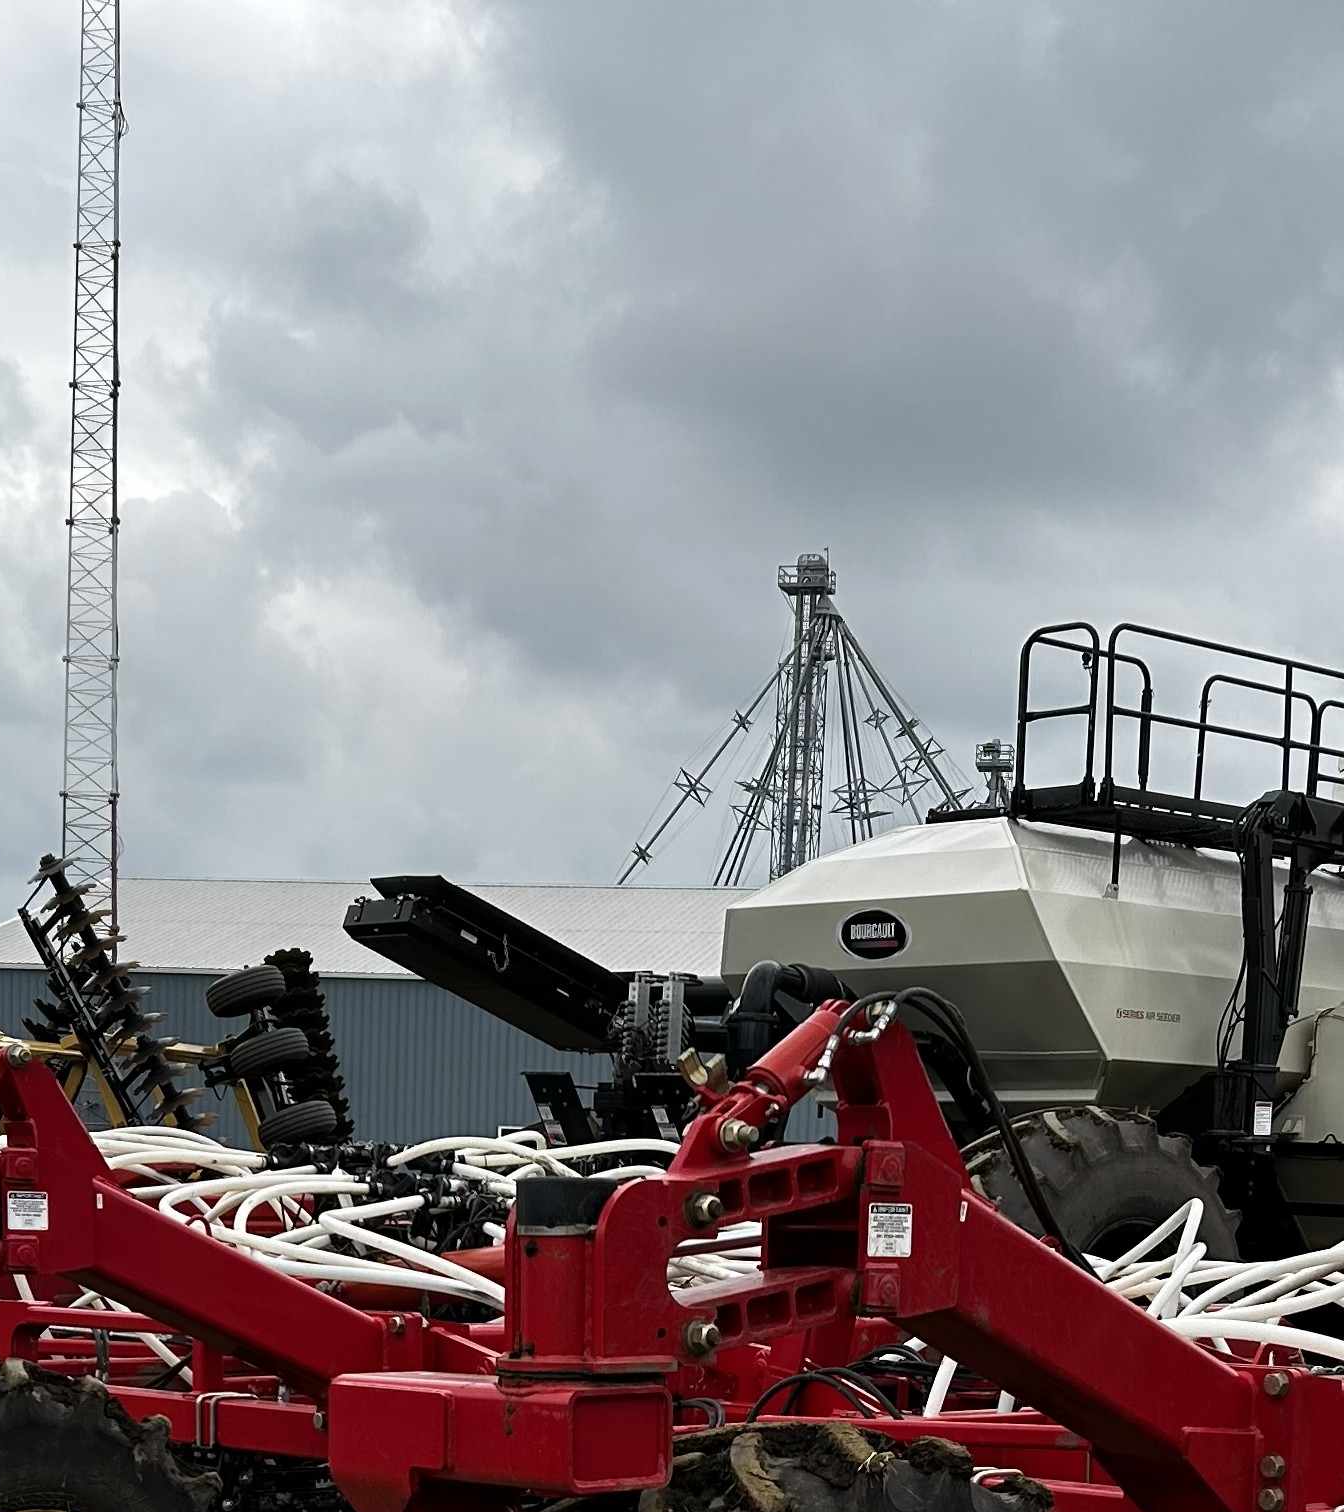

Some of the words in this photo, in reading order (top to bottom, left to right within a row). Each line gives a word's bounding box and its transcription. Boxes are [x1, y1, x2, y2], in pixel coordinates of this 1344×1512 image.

[850, 922, 896, 940] BOURGAULT
[1122, 1009, 1145, 1020] SERIES
[1156, 1011, 1181, 1023] SEEDER
